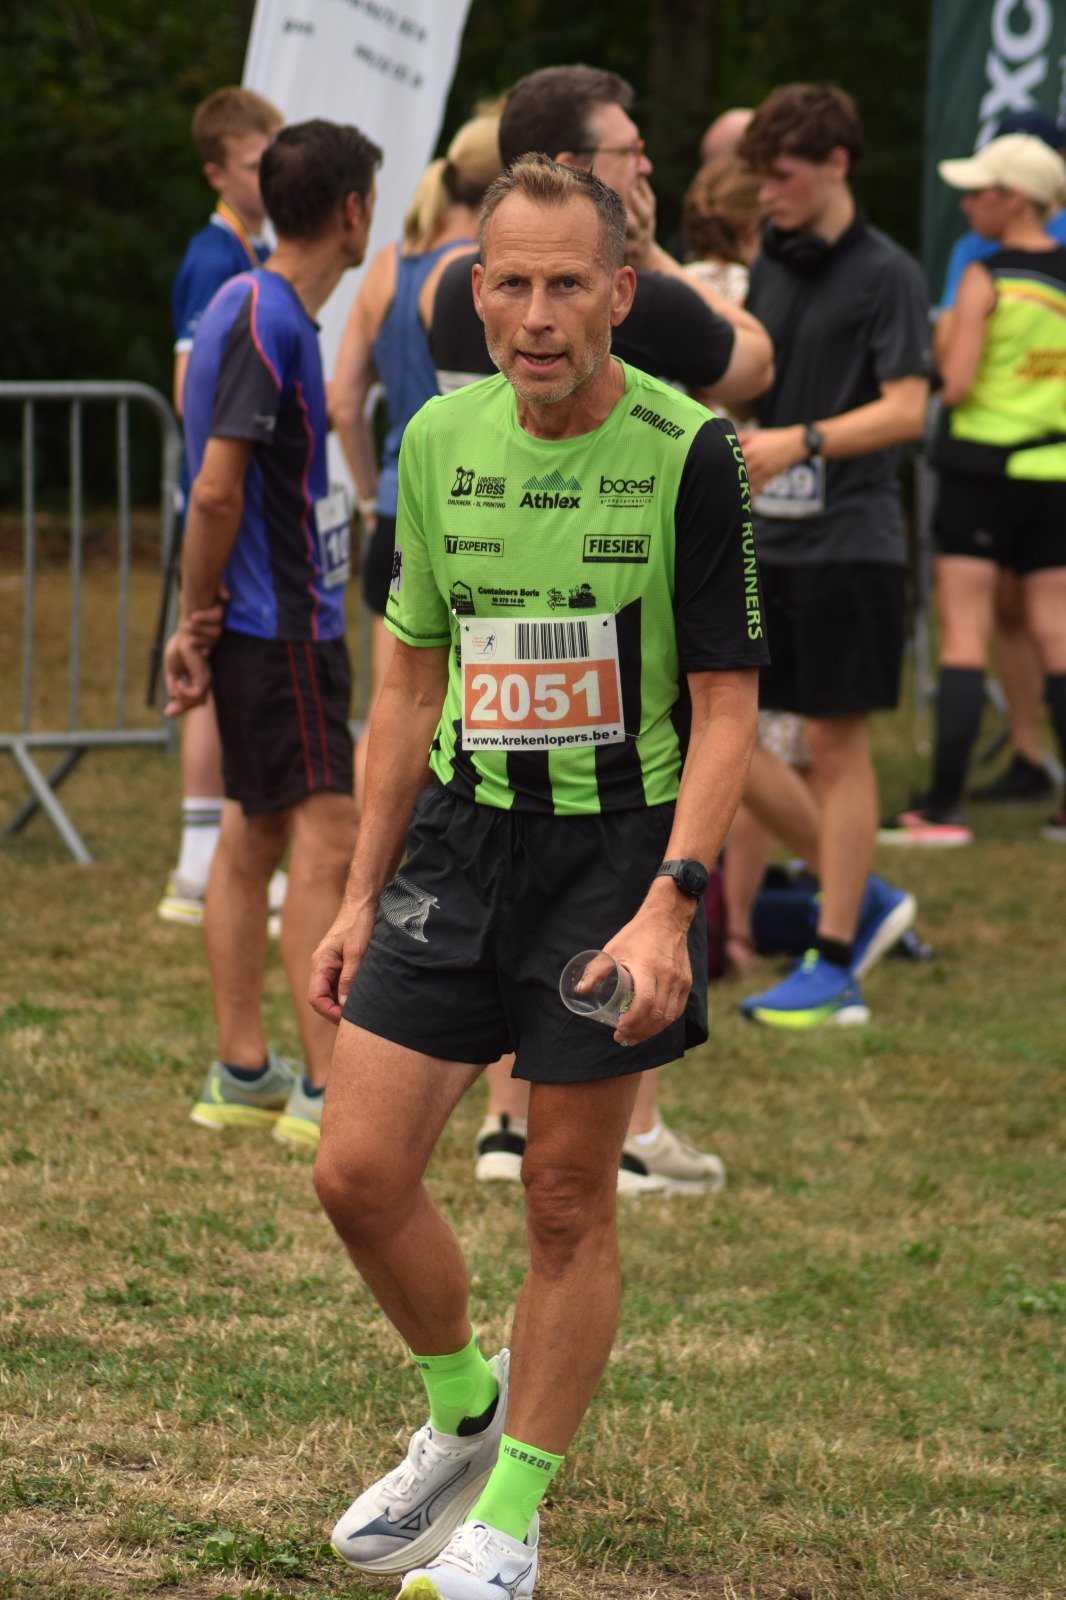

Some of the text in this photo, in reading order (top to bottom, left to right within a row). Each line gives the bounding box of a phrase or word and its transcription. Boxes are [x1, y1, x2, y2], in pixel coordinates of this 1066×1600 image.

[630, 404, 685, 440] BIORACER
[475, 483, 505, 496] press
[519, 491, 582, 509] Athlex
[446, 537, 500, 553] IT EXPERTS
[725, 434, 762, 640] LUCKY RUNNERS
[589, 539, 644, 553] FIESIEK
[478, 586, 539, 597] Containers Boris
[470, 669, 602, 722] 2051
[472, 730, 610, 746] www.krekenlopers.be
[504, 1444, 552, 1472] HERZOG
